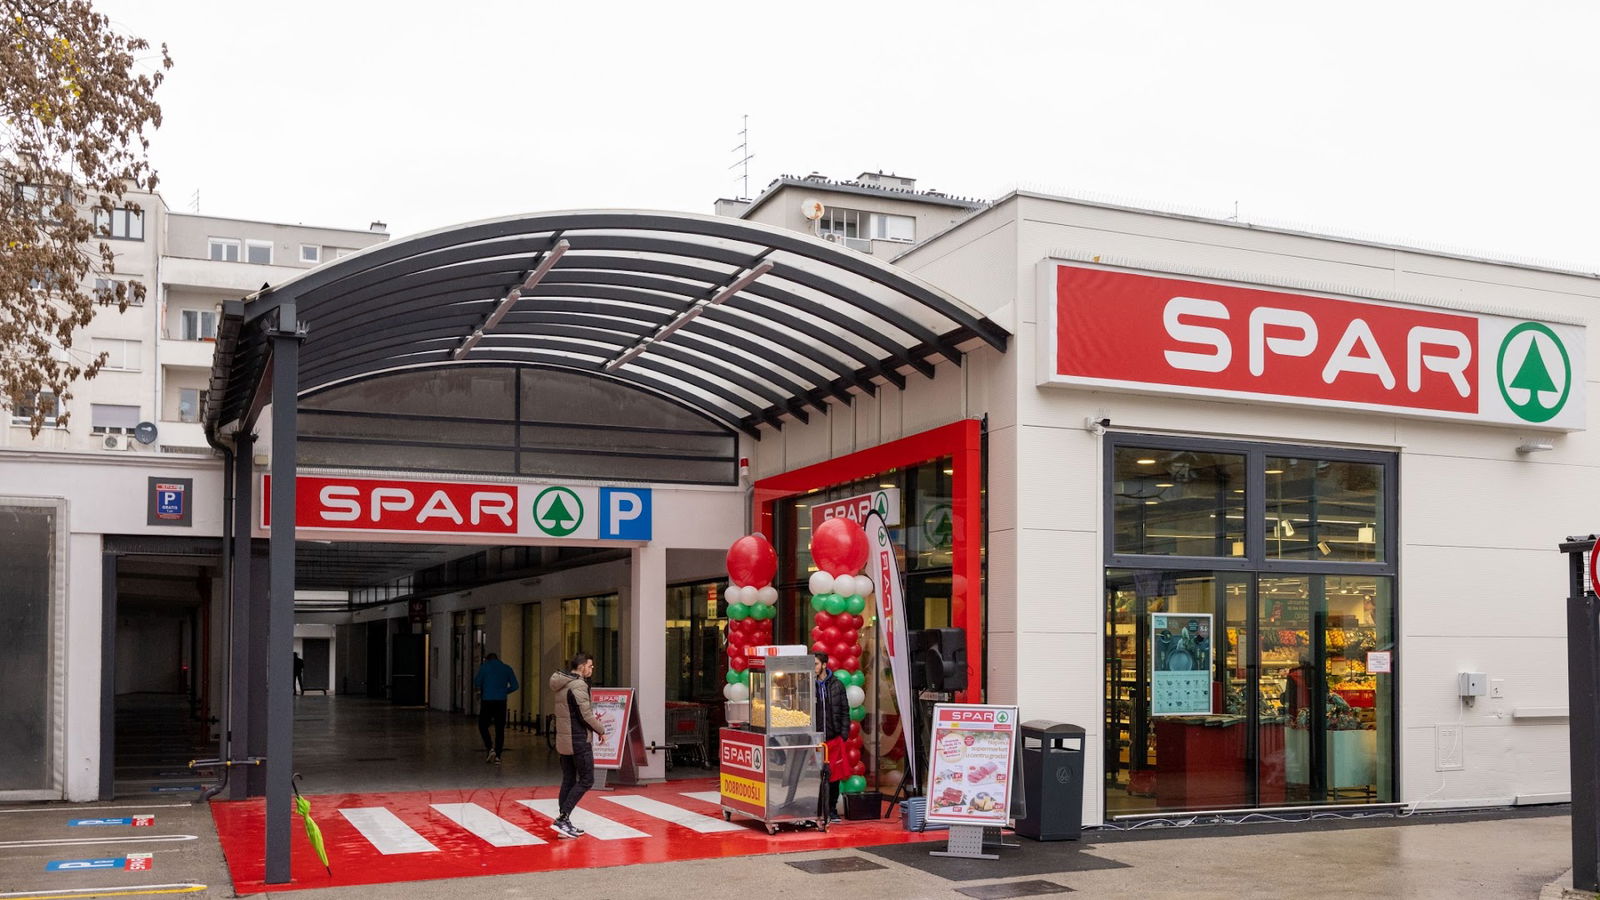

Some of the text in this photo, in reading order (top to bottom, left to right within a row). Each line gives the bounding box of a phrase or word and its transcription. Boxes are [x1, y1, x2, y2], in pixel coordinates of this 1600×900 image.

[1163, 296, 1472, 398] SPAR
[164, 492, 176, 505] P
[319, 485, 514, 526] SPAR
[610, 491, 643, 535] P
[952, 711, 993, 720] SPAR
[723, 746, 752, 764] SPAR
[725, 779, 761, 801] DOBRODOŠLI
